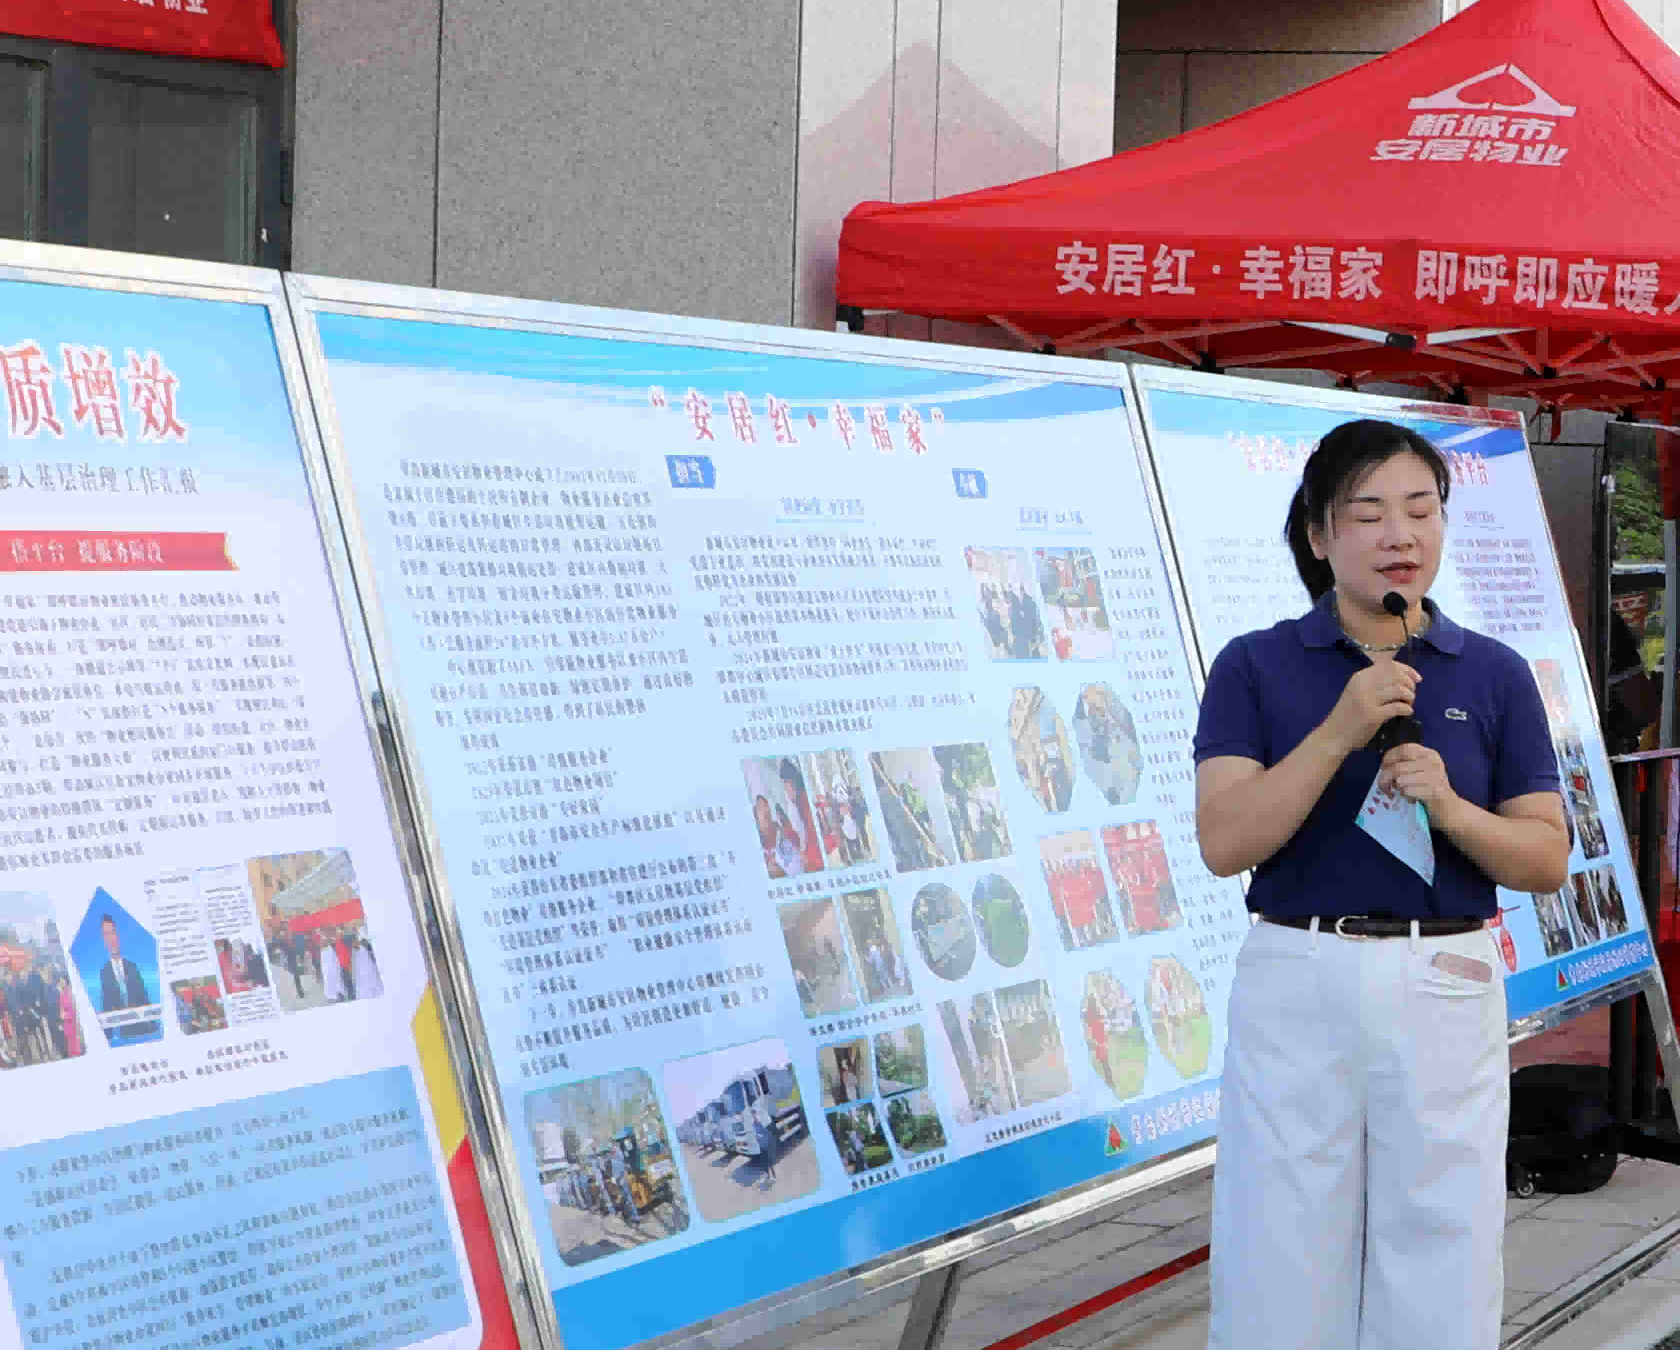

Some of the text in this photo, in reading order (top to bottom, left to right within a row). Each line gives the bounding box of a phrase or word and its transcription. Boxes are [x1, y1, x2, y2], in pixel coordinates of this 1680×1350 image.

[1408, 113, 1557, 140] 新城市
[1370, 138, 1569, 167] 安居物业
[1054, 240, 1384, 303] 安居红·幸福家
